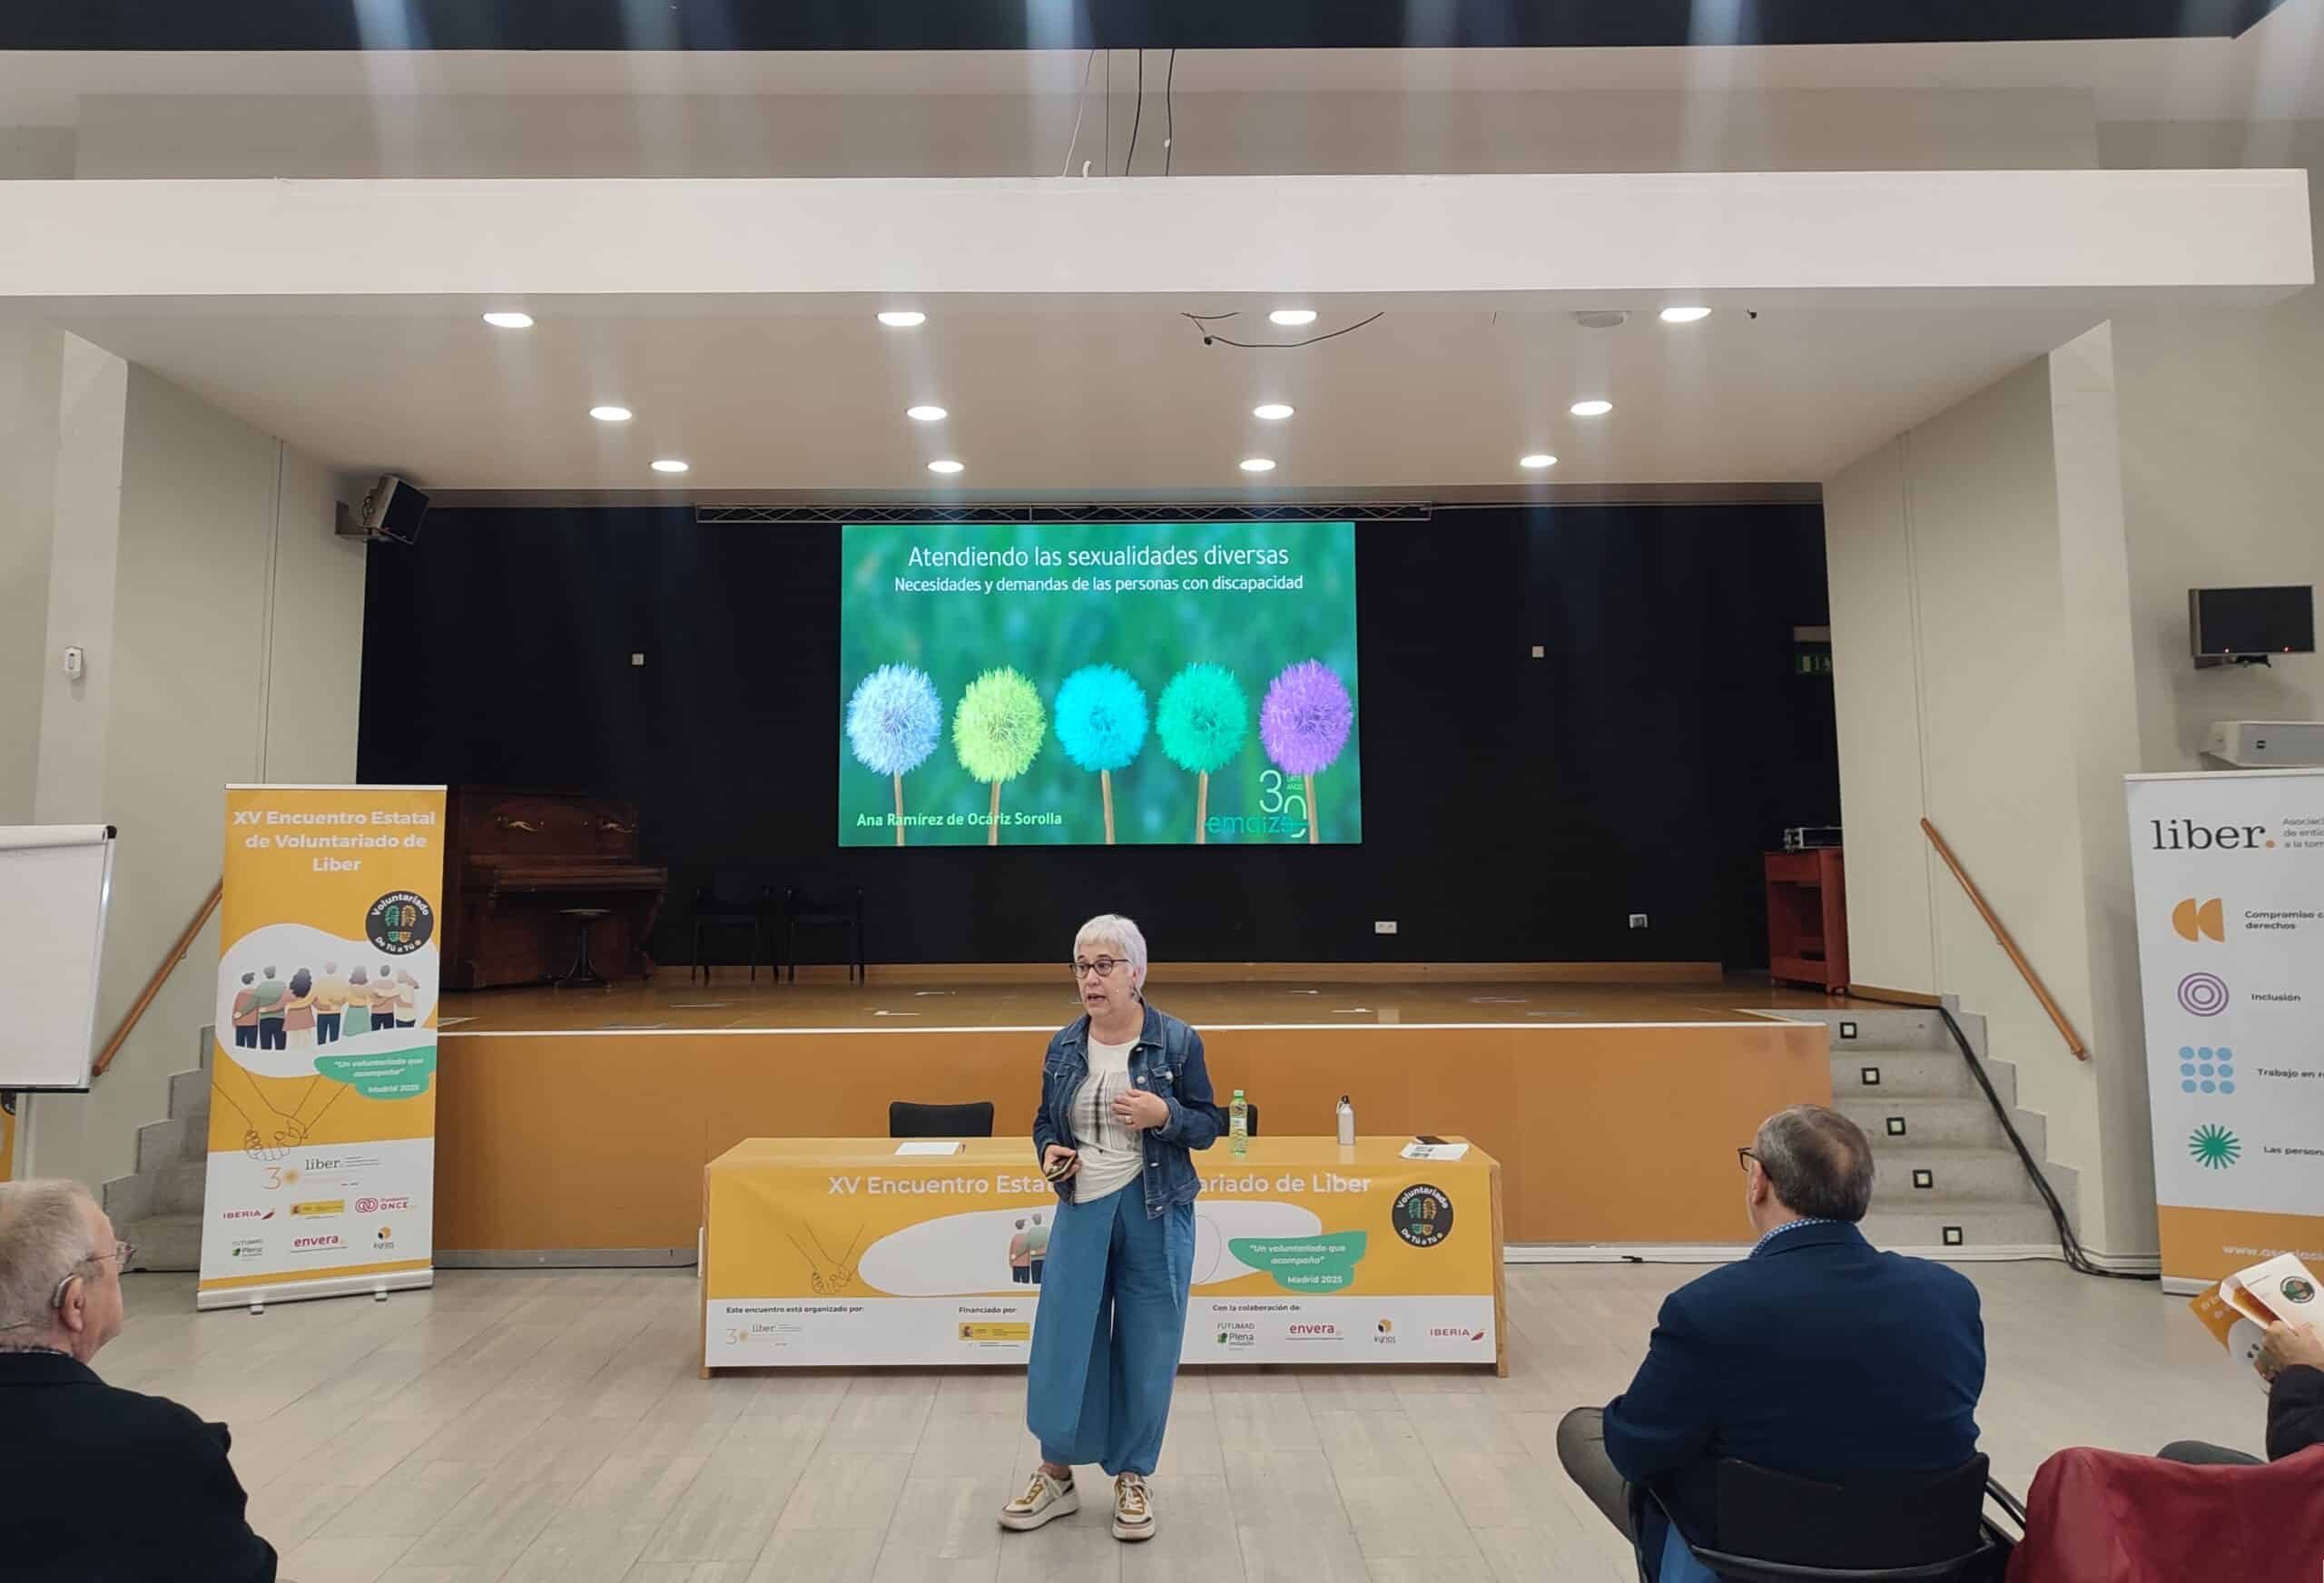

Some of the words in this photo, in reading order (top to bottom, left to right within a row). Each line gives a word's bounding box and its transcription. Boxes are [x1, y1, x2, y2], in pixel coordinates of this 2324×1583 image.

[908, 546, 1029, 566] Atendiendo
[1035, 546, 1061, 566] las
[1068, 545, 1198, 565] sexualidades
[1205, 545, 1289, 565] diversas
[895, 577, 981, 592] Necesidades
[981, 580, 992, 595] y
[996, 577, 1068, 591] demandas
[1072, 576, 1088, 590] de
[1093, 576, 1111, 590] las
[1115, 578, 1178, 594] personas
[1183, 578, 1208, 590] con
[1212, 575, 1303, 593] discapacidad
[233, 811, 261, 825] XV
[267, 811, 367, 825] Encuentro
[371, 811, 436, 825] Estatal
[857, 813, 882, 826] Ana
[887, 812, 943, 826] Ramírez
[947, 813, 963, 825] de
[967, 812, 1011, 825] Ocáriz
[1014, 811, 1062, 825] Sorolla
[2283, 828, 2297, 837] de
[245, 834, 270, 849] de
[275, 833, 399, 848] Voluntariado
[403, 833, 427, 848] de
[313, 857, 362, 871] Liber
[371, 893, 429, 915] Voluntariado
[2244, 909, 2315, 919] Compromiso
[2245, 922, 2296, 930] derechos
[2250, 992, 2302, 1002] Inclusión
[2258, 1067, 2299, 1078] Trabajo
[2264, 1145, 2281, 1154] Las
[2285, 1147, 2324, 1155] person
[828, 1176, 861, 1195] XV
[867, 1175, 989, 1194] Encuentro
[996, 1175, 1054, 1194] Estat
[1199, 1173, 1270, 1194] ariado
[1275, 1173, 1305, 1194] de
[1313, 1172, 1372, 1194] Liber
[1396, 1186, 1448, 1208] Voluntariado
[379, 1201, 408, 1211] ONCE
[223, 1209, 262, 1219] IBERIA
[294, 1234, 339, 1248] envera
[1287, 1275, 1319, 1283] Madrid
[786, 1305, 803, 1313] está
[804, 1305, 848, 1314] organizado
[1229, 1303, 1236, 1312] la
[1237, 1303, 1288, 1312] colaboración
[1289, 1323, 1334, 1334] envera
[1430, 1328, 1471, 1336] IBERIA
